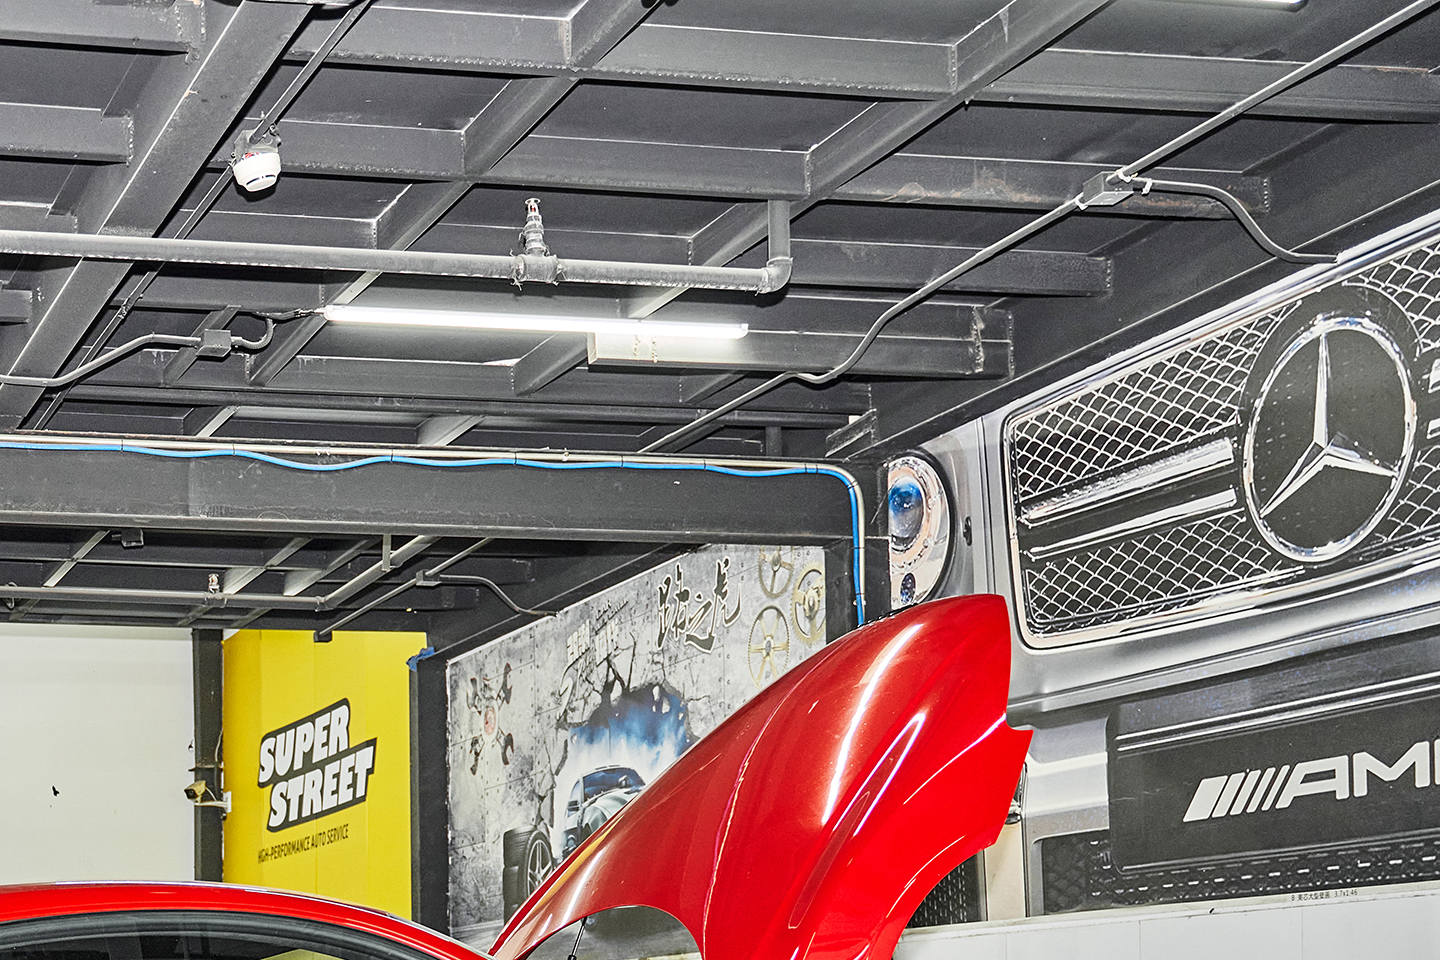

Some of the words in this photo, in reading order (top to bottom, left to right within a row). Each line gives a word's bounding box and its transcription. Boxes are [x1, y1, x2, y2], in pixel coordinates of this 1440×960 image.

[258, 704, 349, 783] SUPER
[1275, 738, 1440, 809] AM
[268, 745, 374, 828] STREET
[311, 831, 327, 849] AUTO
[327, 823, 349, 845] SERVICE
